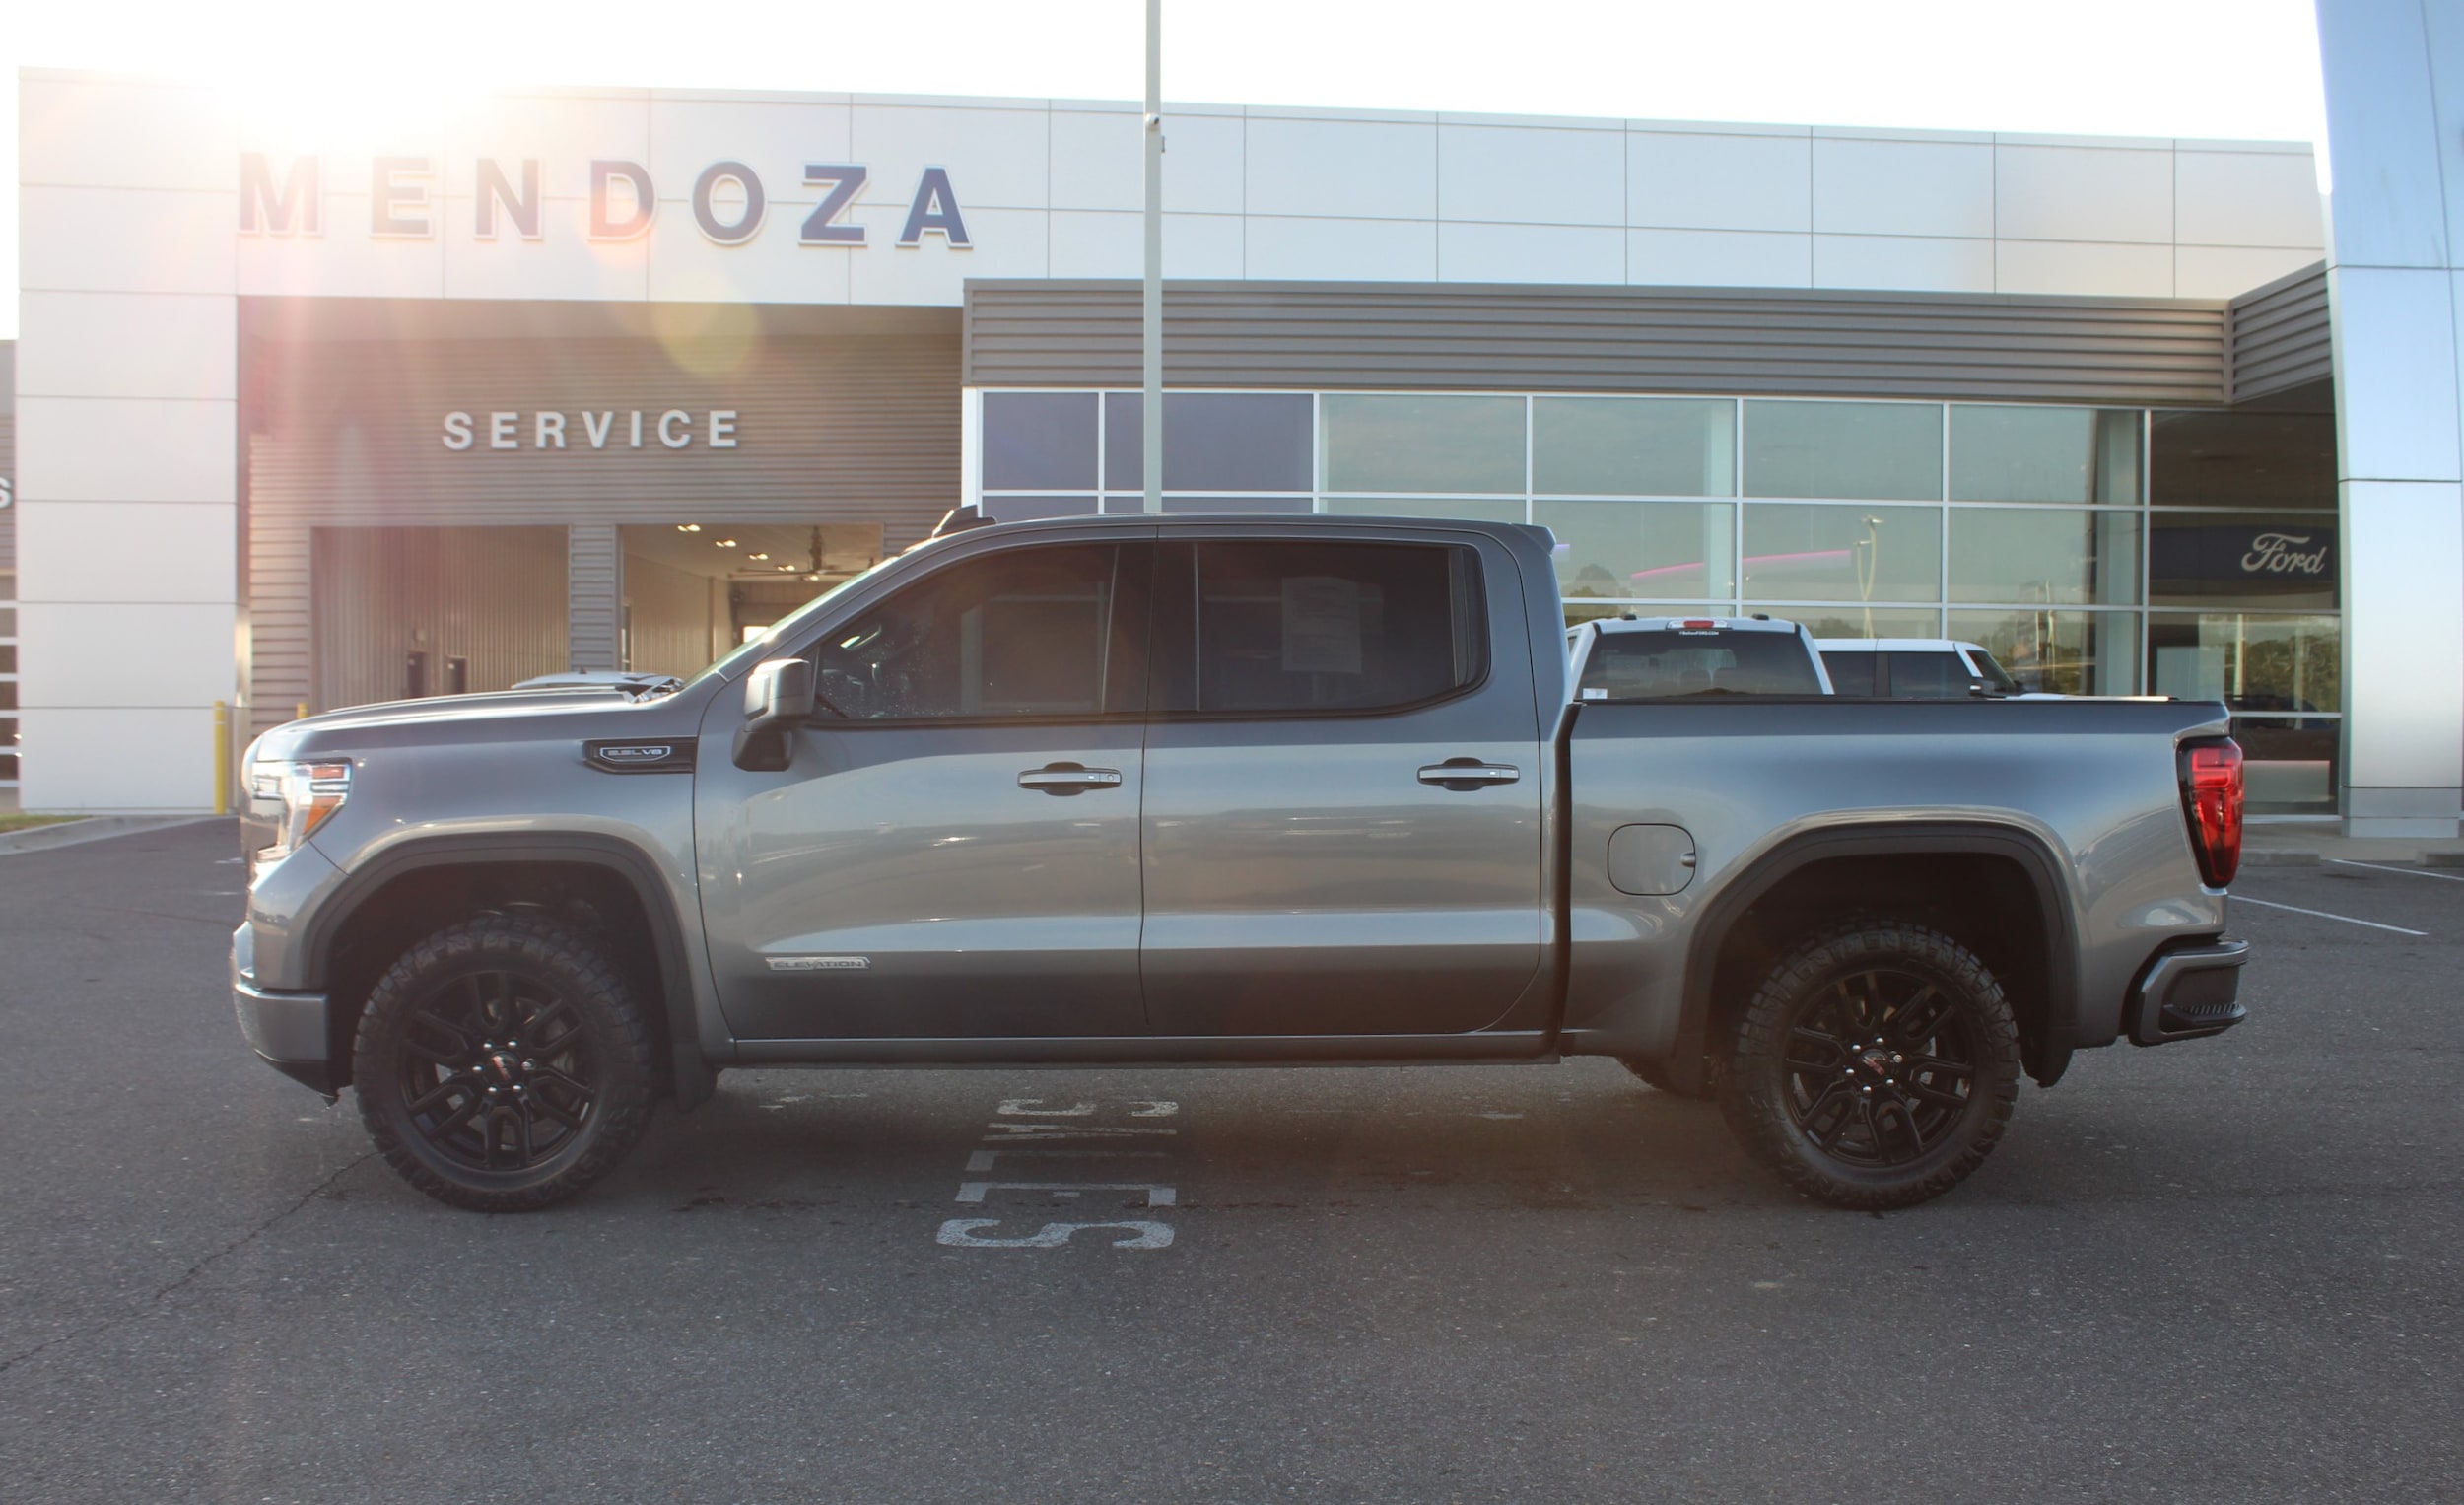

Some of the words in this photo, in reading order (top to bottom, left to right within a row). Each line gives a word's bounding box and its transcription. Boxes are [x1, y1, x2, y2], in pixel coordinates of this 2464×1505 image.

[237, 152, 974, 249] MENDOZA
[443, 409, 737, 450] SERVICE
[2240, 532, 2327, 573] Ford
[772, 959, 864, 970] ELEVATION
[936, 1098, 1179, 1248] SALES
